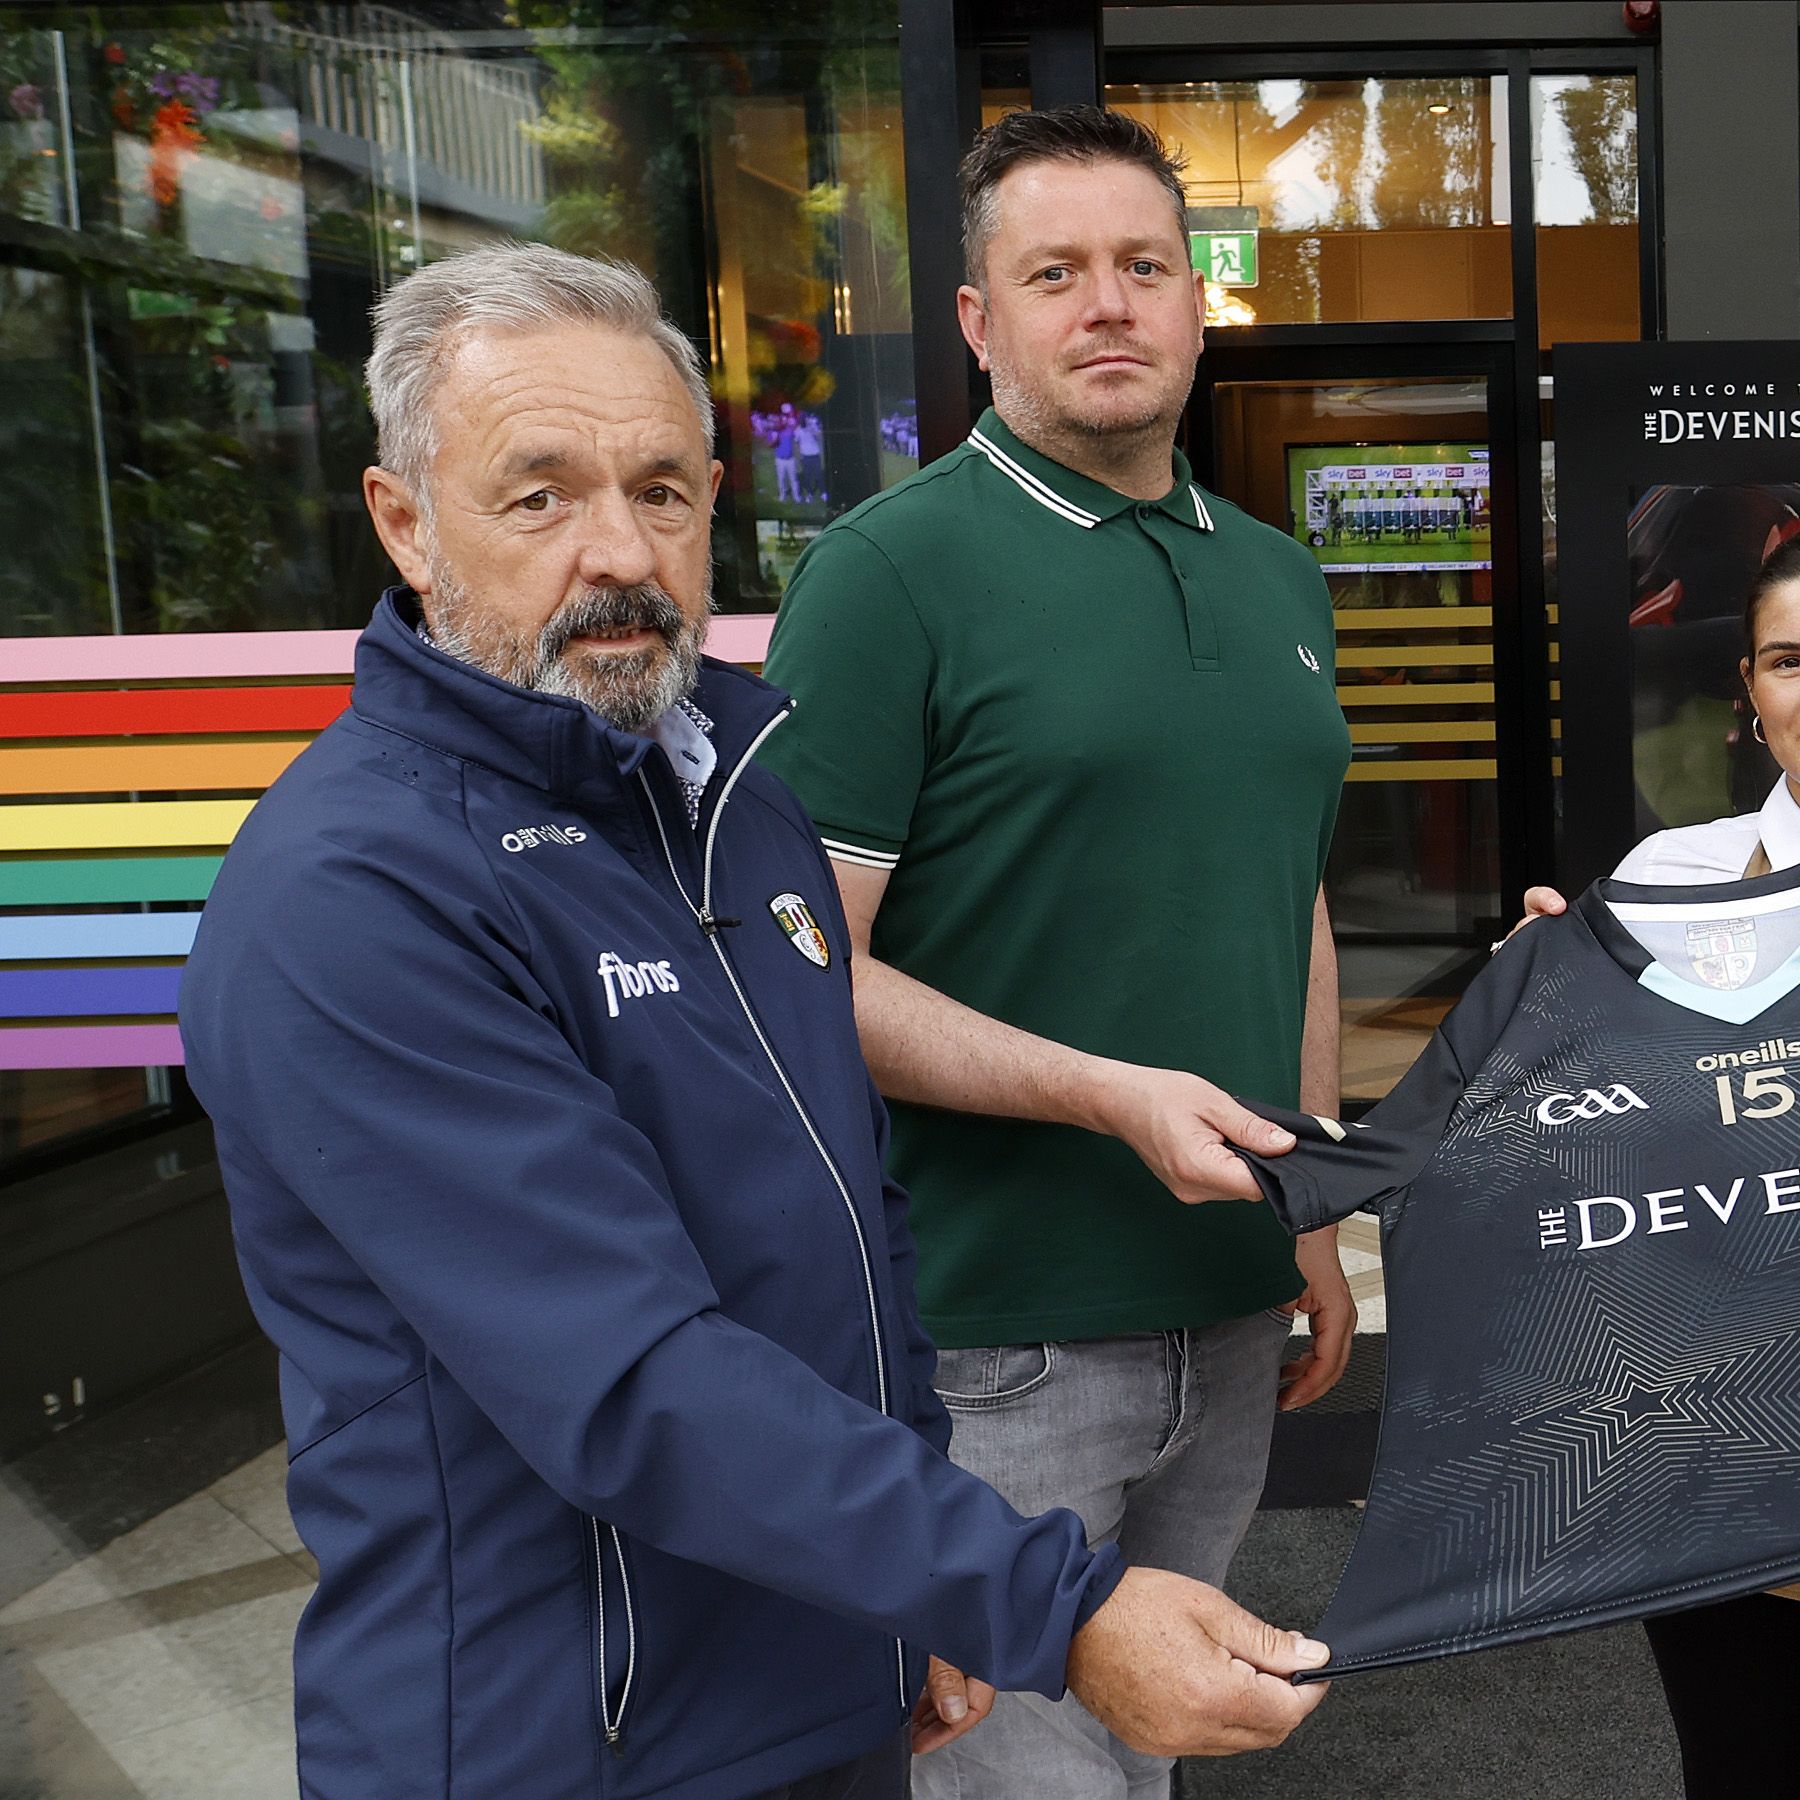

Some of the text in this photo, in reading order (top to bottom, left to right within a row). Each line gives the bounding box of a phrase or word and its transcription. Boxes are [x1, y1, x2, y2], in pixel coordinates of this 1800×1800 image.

[1650, 384, 1775, 396] WELCOME
[1644, 411, 1658, 440] THE
[1327, 469, 1366, 480] sky bet
[1375, 468, 1411, 479] sky bet
[1427, 467, 1464, 478] sky bet
[1714, 1067, 1797, 1126] 15
[1538, 1206, 1568, 1250] THE
